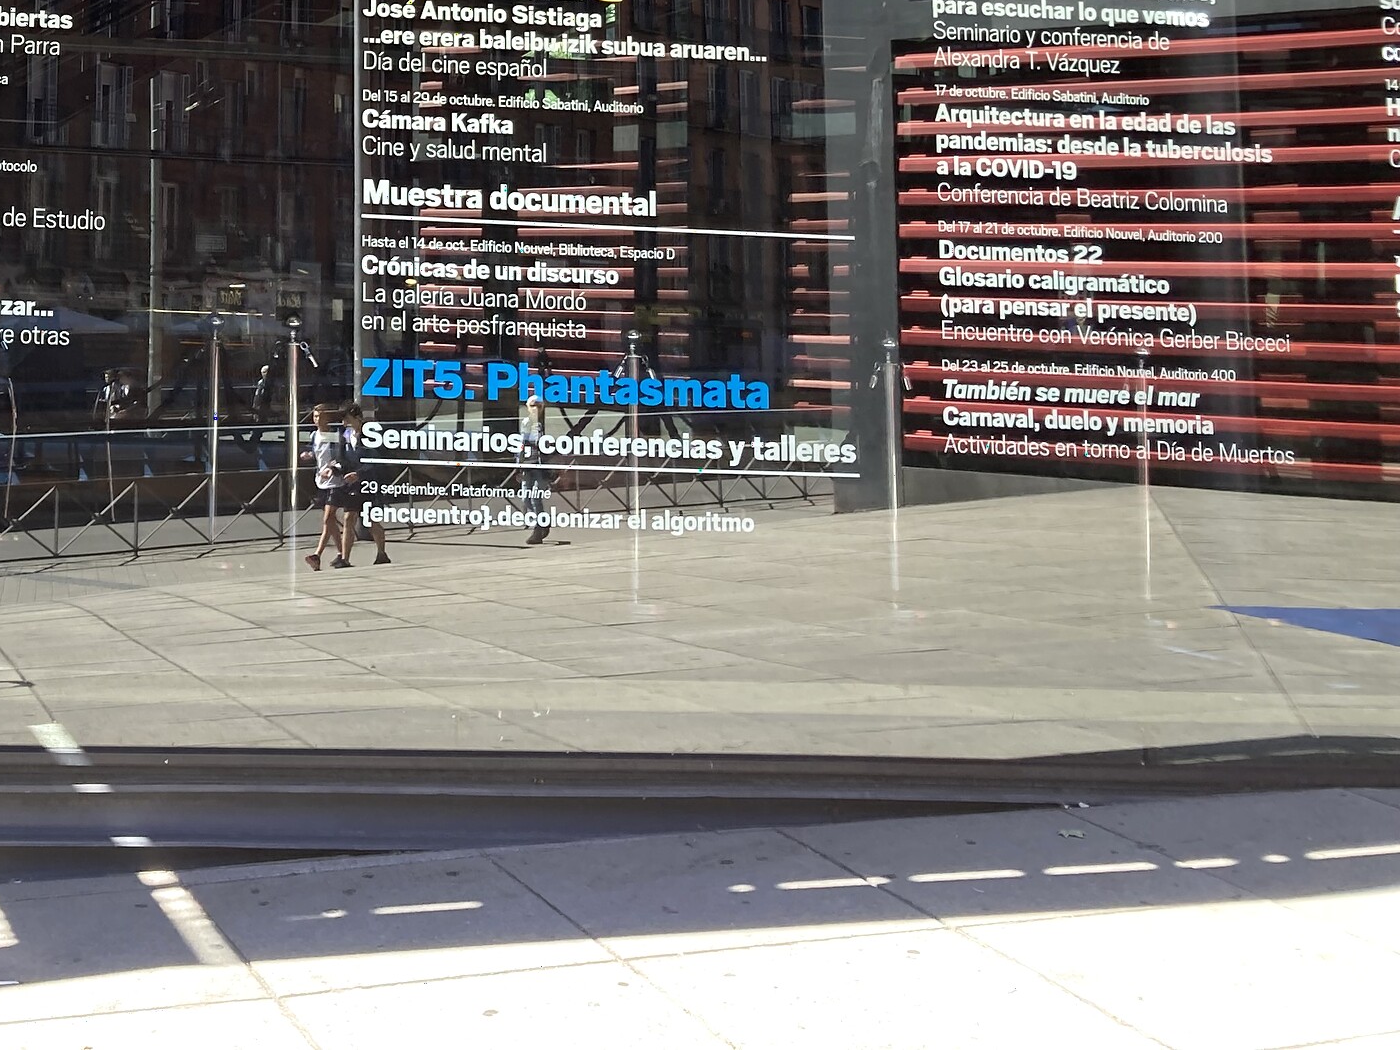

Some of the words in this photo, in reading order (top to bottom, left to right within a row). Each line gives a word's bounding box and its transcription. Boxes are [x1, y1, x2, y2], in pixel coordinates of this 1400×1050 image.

[420, 0, 507, 24] Antonio
[512, 4, 602, 33] Sistiaga
[934, 46, 1020, 69] Alexandra
[1026, 51, 1041, 70] T.
[1047, 52, 1121, 76] Vázquez
[935, 84, 946, 97] 17
[950, 85, 963, 98] de
[966, 86, 1009, 100] octubre.
[1012, 87, 1051, 102] Edificio
[1053, 89, 1100, 106] Sabatini,
[1102, 91, 1150, 106] Auditorio
[363, 108, 445, 132] Cámara
[449, 113, 513, 135] Kafka
[363, 136, 404, 157] Cine
[410, 142, 420, 162] y
[426, 139, 475, 160] salud
[483, 144, 546, 164] mental
[362, 180, 483, 209] Muestra
[490, 186, 657, 217] documental
[939, 241, 1069, 264] Documentos
[1073, 246, 1103, 265] 22
[362, 255, 459, 278] Crónicas
[463, 259, 490, 279] de
[495, 265, 523, 280] un
[527, 262, 620, 285] discurso
[939, 268, 1024, 289] Glosario
[1029, 271, 1169, 294] caligramático
[941, 321, 1034, 342] Encuentro
[1039, 329, 1072, 344] con
[1077, 326, 1154, 347] Verónica
[1160, 329, 1220, 350] Gerber
[1226, 332, 1291, 352] Bicceci
[362, 358, 474, 400] ZIT5.
[487, 362, 769, 408] Phantasmata
[943, 408, 1041, 432] Carnaval,
[1045, 411, 1102, 431] duelo
[1106, 417, 1120, 436] y
[1125, 415, 1215, 434] memoria
[361, 424, 532, 457] Seminarios,
[539, 431, 723, 459] conferencias
[729, 441, 746, 465] y
[752, 437, 857, 463] talleres
[361, 481, 378, 495] 29
[381, 482, 449, 498] septiembre.
[452, 483, 515, 498] Plataforma
[517, 485, 552, 499] online
[628, 509, 647, 530] el
[652, 510, 755, 536] algoritmo
